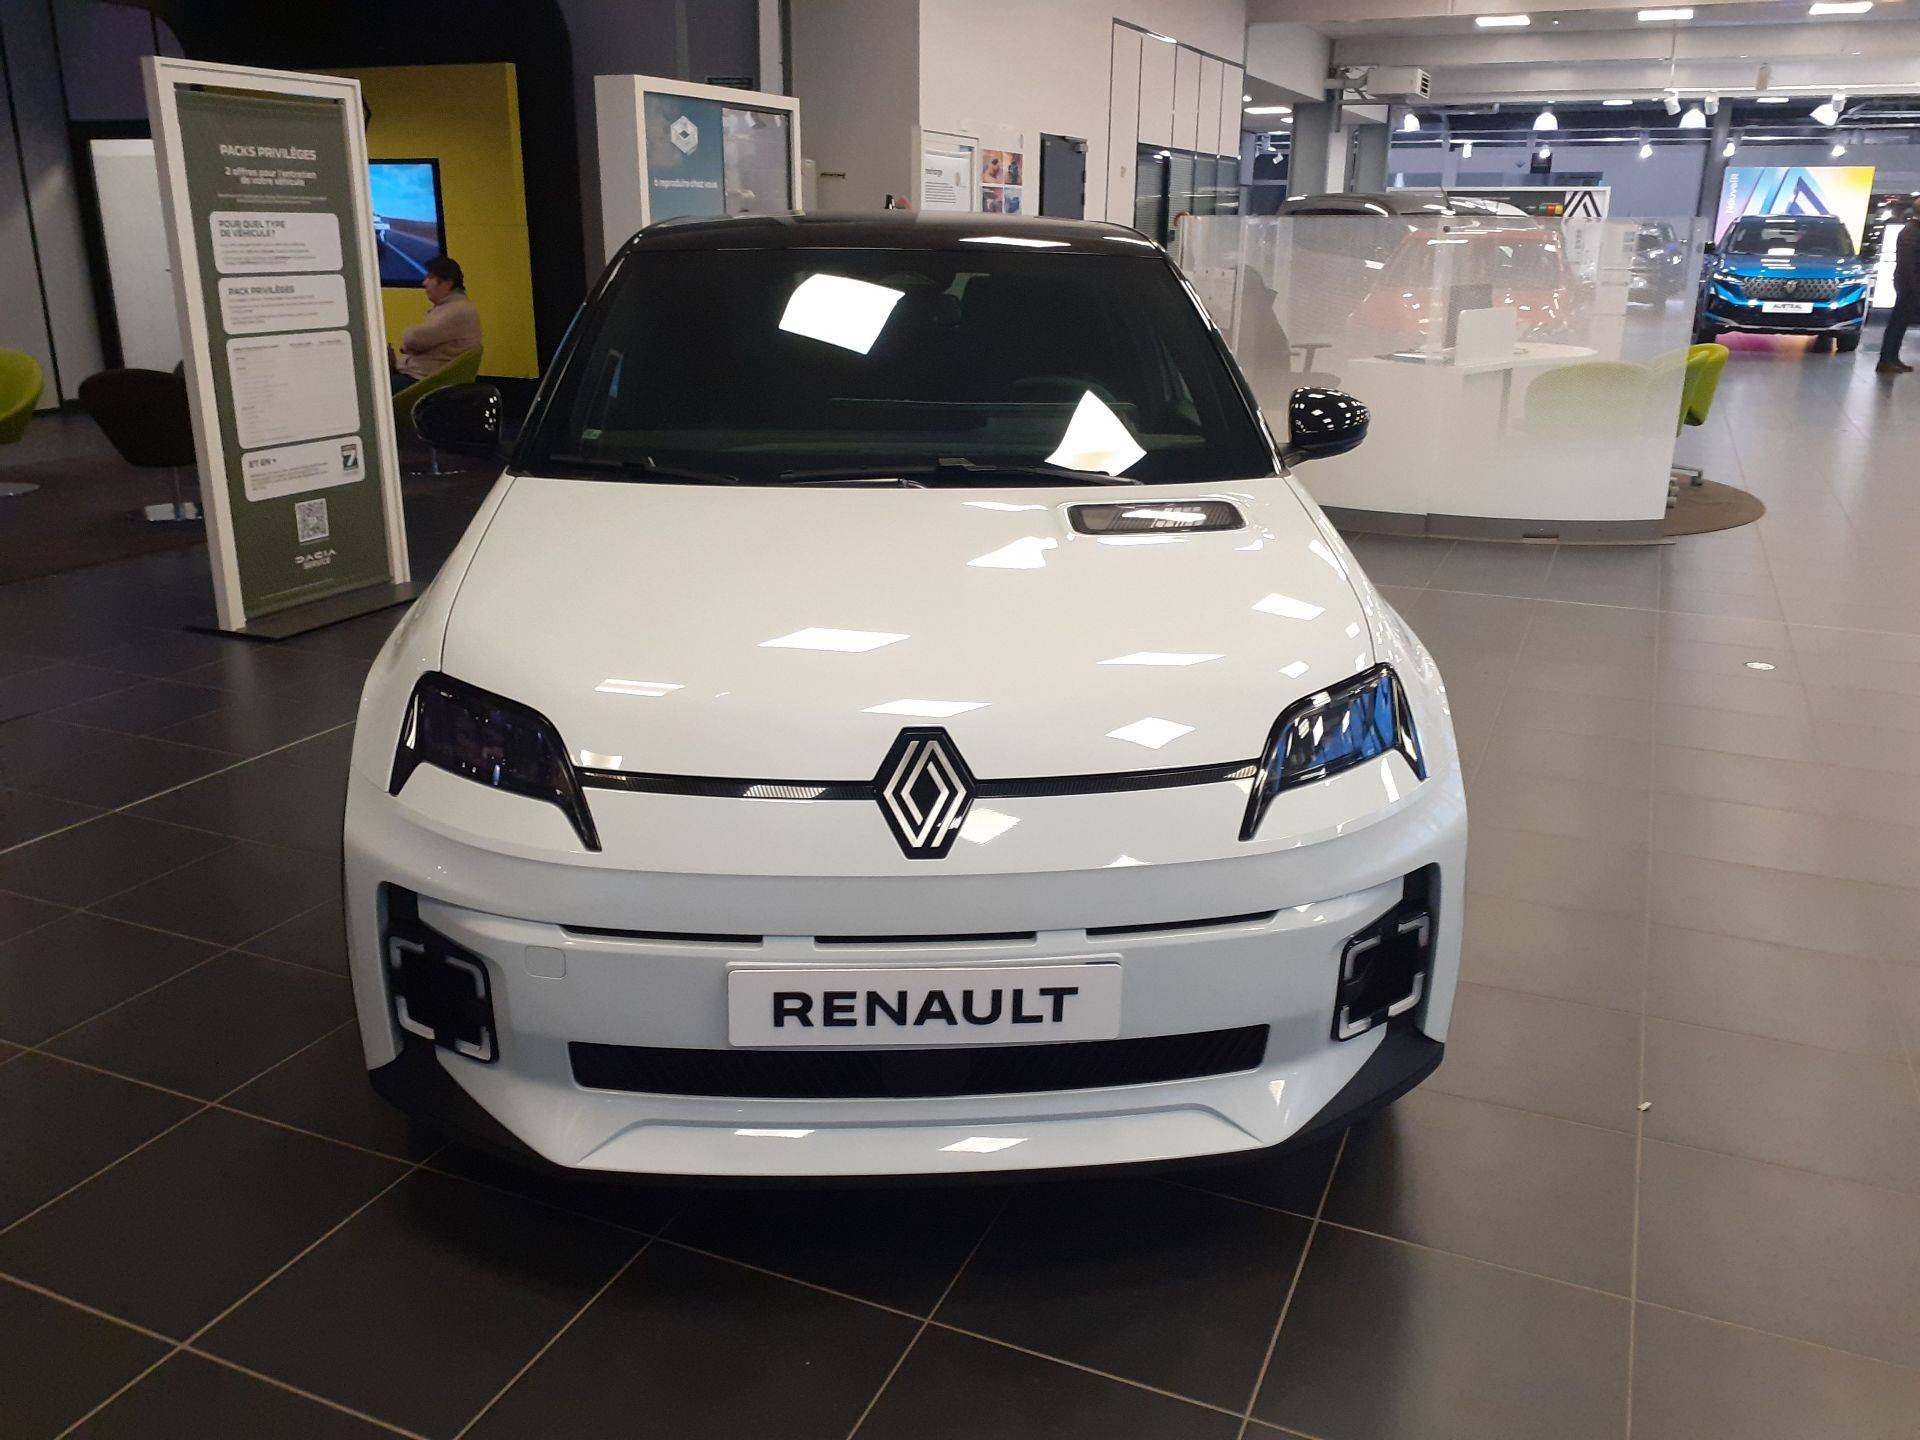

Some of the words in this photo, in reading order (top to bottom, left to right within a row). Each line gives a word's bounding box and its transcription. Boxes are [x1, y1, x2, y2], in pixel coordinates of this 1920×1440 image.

[219, 144, 257, 157] PACKS
[257, 146, 317, 161] PRIVILÈGES
[224, 166, 231, 176] 2
[218, 220, 242, 229] POUR
[243, 220, 264, 229] QUEL
[265, 220, 285, 229] TYPE
[220, 229, 231, 237] DE
[228, 286, 249, 296] PACK
[250, 284, 295, 295] PRIVILÈGES
[295, 549, 337, 564] DACIA
[773, 986, 1079, 1027] RENAULT
